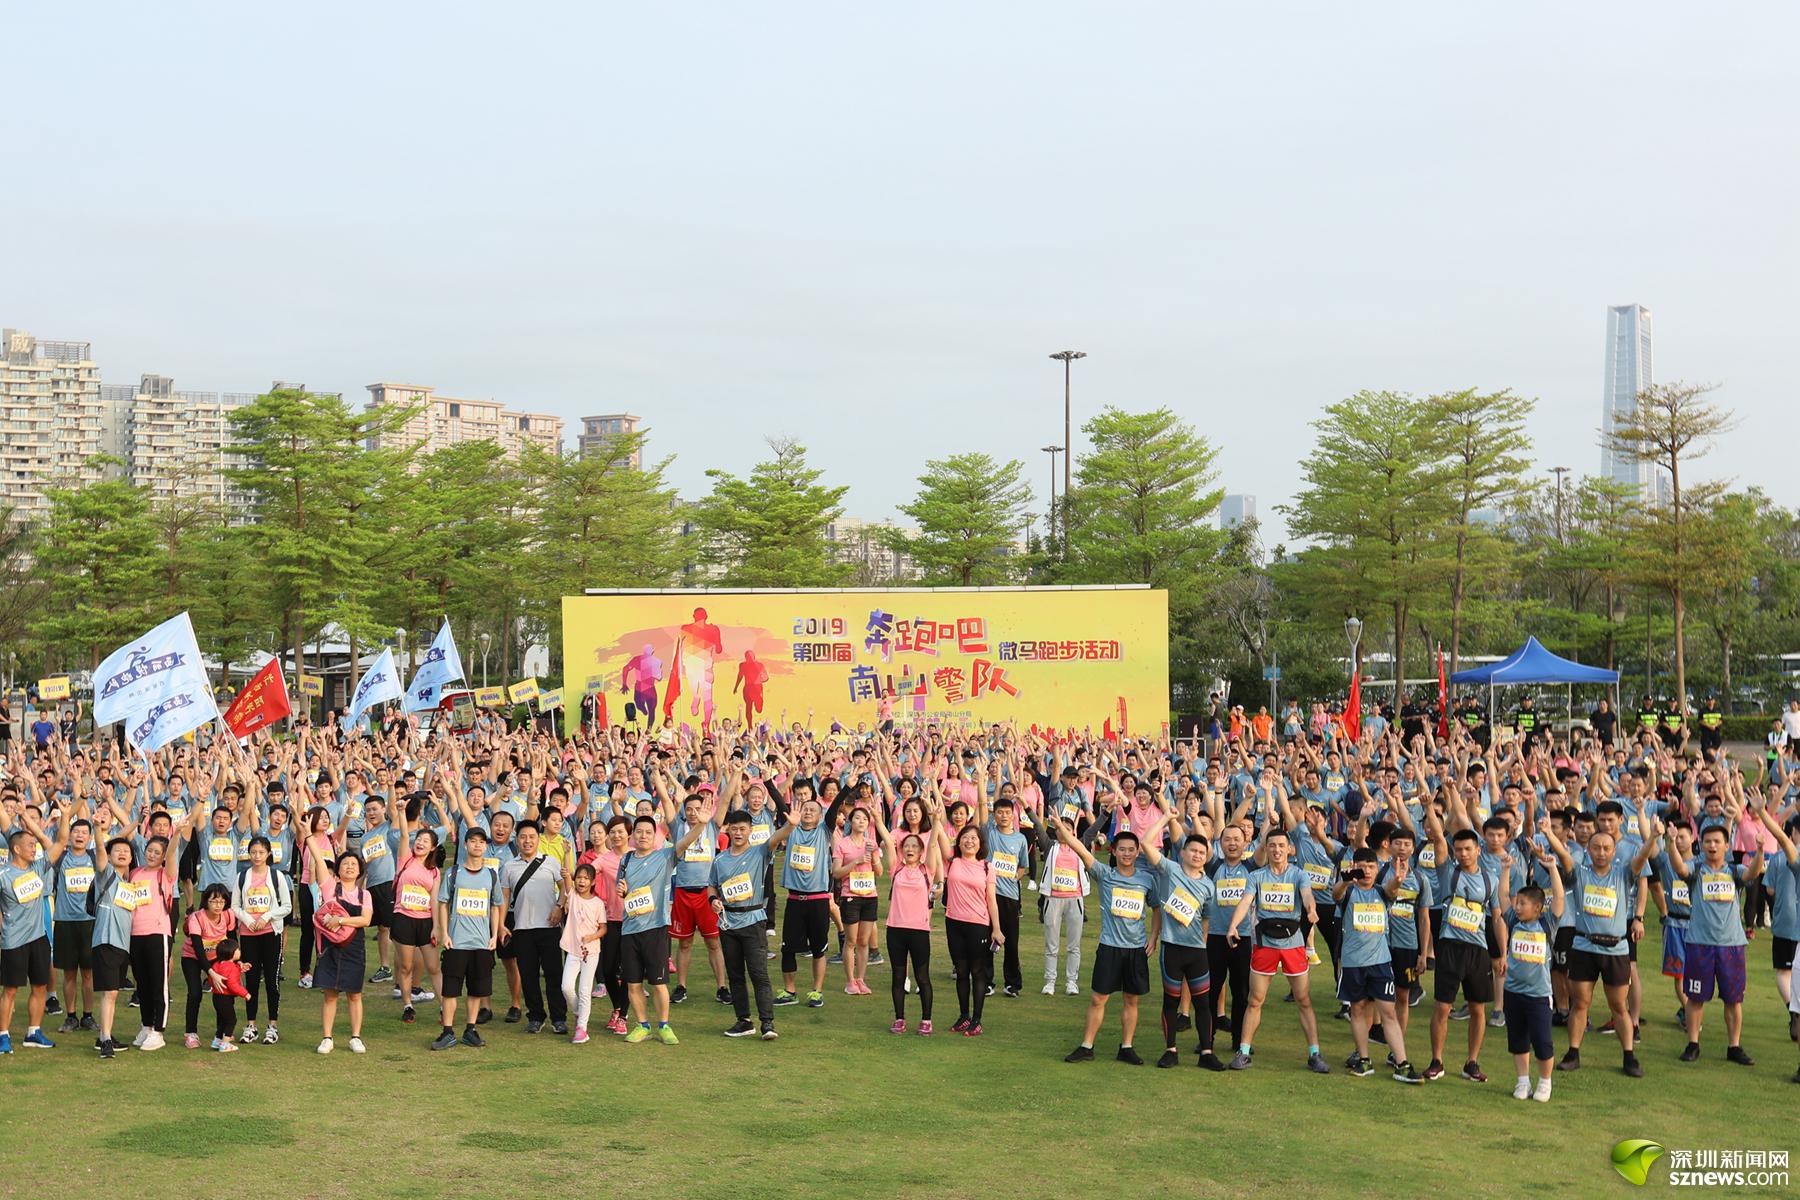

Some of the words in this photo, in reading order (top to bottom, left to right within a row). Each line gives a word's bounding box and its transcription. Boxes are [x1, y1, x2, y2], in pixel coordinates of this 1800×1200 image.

[793, 618, 843, 636] 2019
[865, 608, 988, 662] 奔跑吧
[793, 643, 852, 662] 第四届
[999, 640, 1119, 661] 微马跑步活动
[849, 658, 1018, 704] 南山警队
[751, 833, 769, 841] 0038
[366, 843, 383, 856] 0724
[792, 855, 811, 864] 0185
[1422, 852, 1434, 861] 02
[995, 861, 1015, 872] 0036
[854, 880, 872, 889] 0042
[1054, 877, 1074, 886] 0035
[1707, 883, 1732, 892] 0239
[20, 881, 41, 896] 0526
[727, 883, 749, 896] 0193
[248, 897, 269, 906] 0540
[404, 894, 427, 905] H058
[461, 899, 485, 909] 0191
[628, 896, 650, 909] 0195
[1115, 899, 1140, 911] 0280
[1265, 894, 1290, 903] 0273
[1585, 895, 1612, 909] 005A
[1170, 897, 1193, 917] 0262
[1450, 907, 1478, 923] 005D
[1515, 943, 1543, 954] H015
[1385, 982, 1395, 995] 10
[1689, 979, 1701, 993] 19
